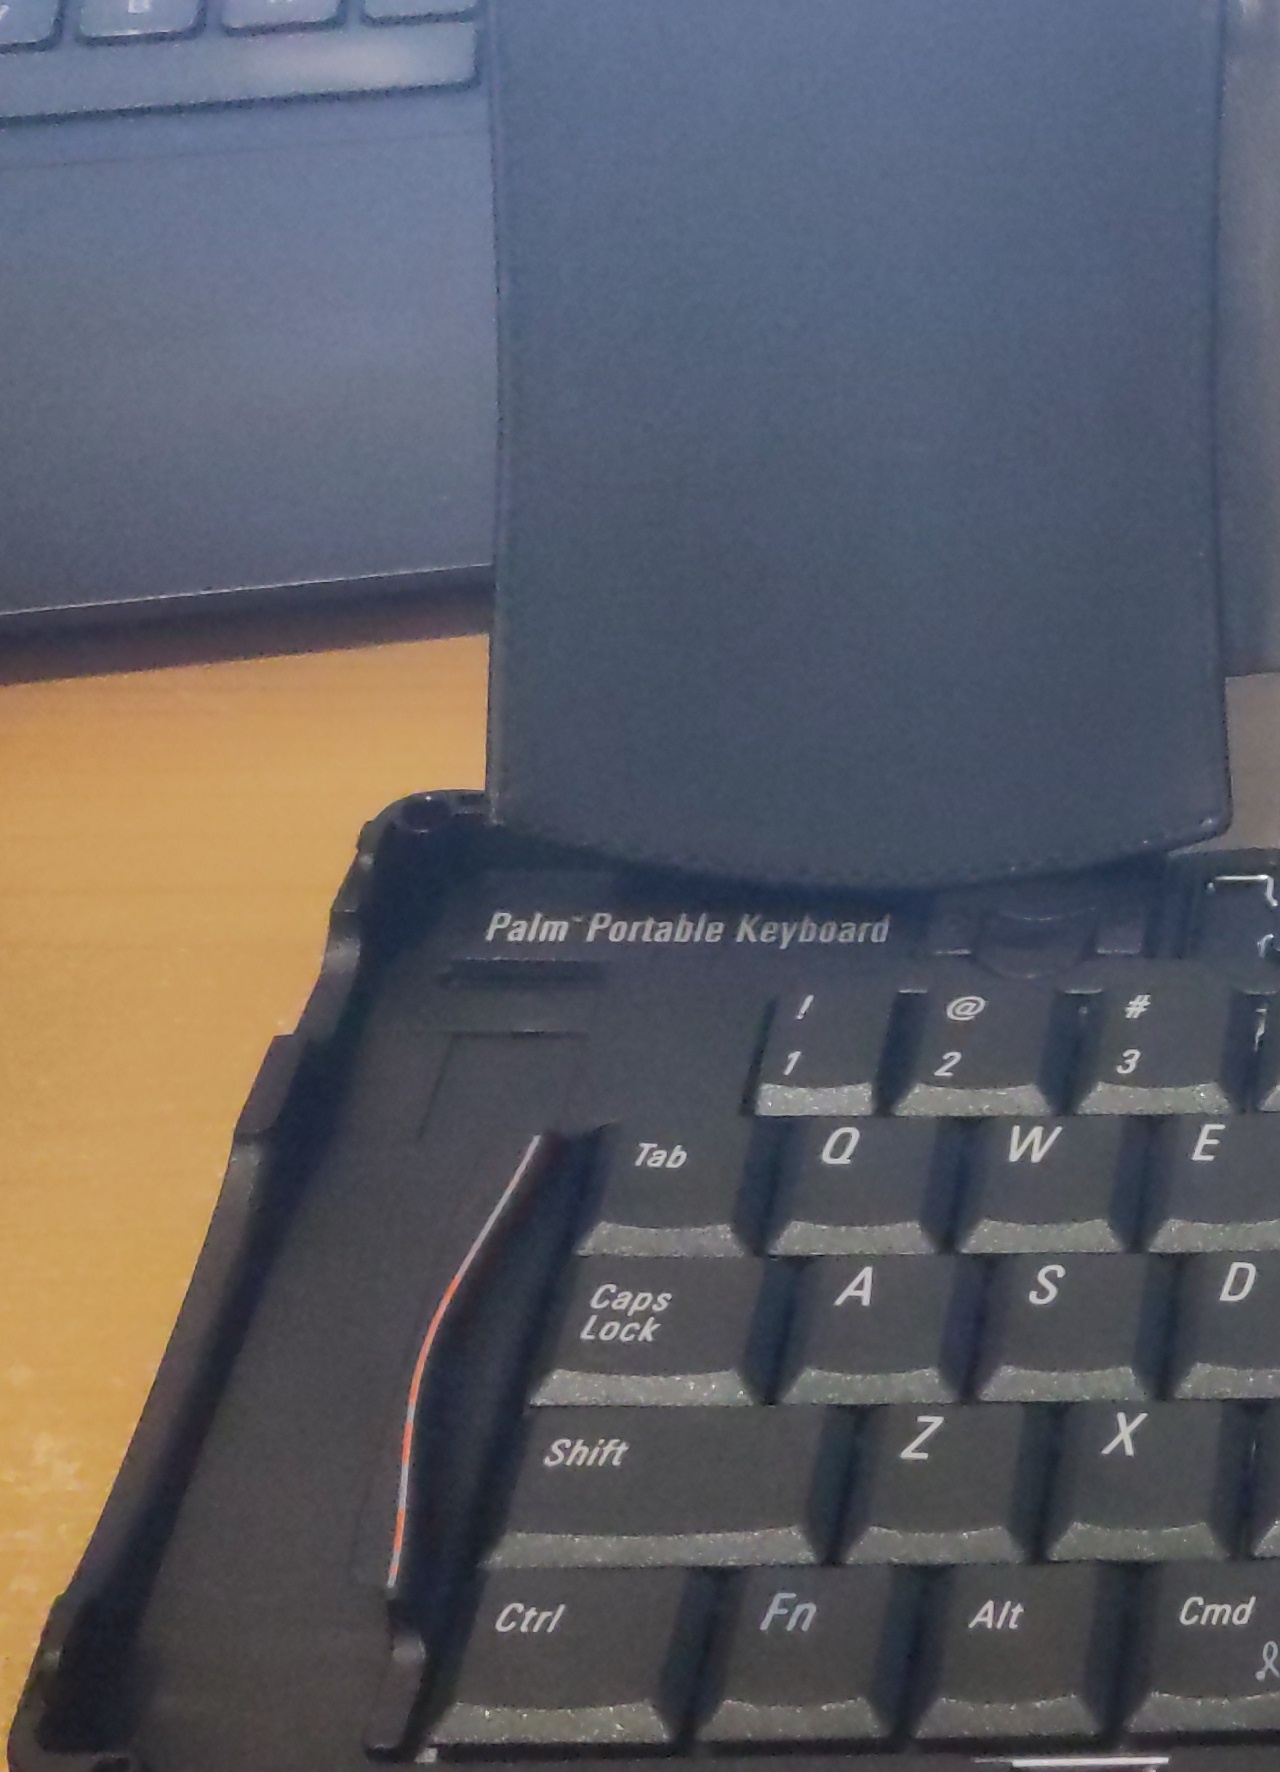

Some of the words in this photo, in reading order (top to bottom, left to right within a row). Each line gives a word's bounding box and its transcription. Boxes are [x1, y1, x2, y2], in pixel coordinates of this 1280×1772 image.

[586, 913, 723, 942] Portable
[736, 915, 888, 949] Keyboard
[796, 995, 813, 1019] !
[947, 996, 986, 1021] @
[1126, 995, 1150, 1018] #
[784, 1051, 801, 1075] 1
[934, 1052, 961, 1077] 2
[1117, 1049, 1140, 1074] 3
[635, 1143, 687, 1168] Tab
[821, 1127, 860, 1164] Q
[1009, 1126, 1062, 1163] W
[1192, 1124, 1225, 1161] E
[835, 1266, 872, 1306] A
[1029, 1265, 1065, 1305] S
[1220, 1262, 1256, 1302] D
[590, 1284, 672, 1314] Caps
[581, 1314, 660, 1342] Lock
[900, 1416, 944, 1459] Z
[1102, 1412, 1147, 1455] X
[544, 1439, 628, 1467] Shift
[496, 1603, 565, 1632] Ctrl
[760, 1593, 816, 1631] Fn
[969, 1600, 1023, 1629] Alt
[1180, 1596, 1255, 1625] Cmd
